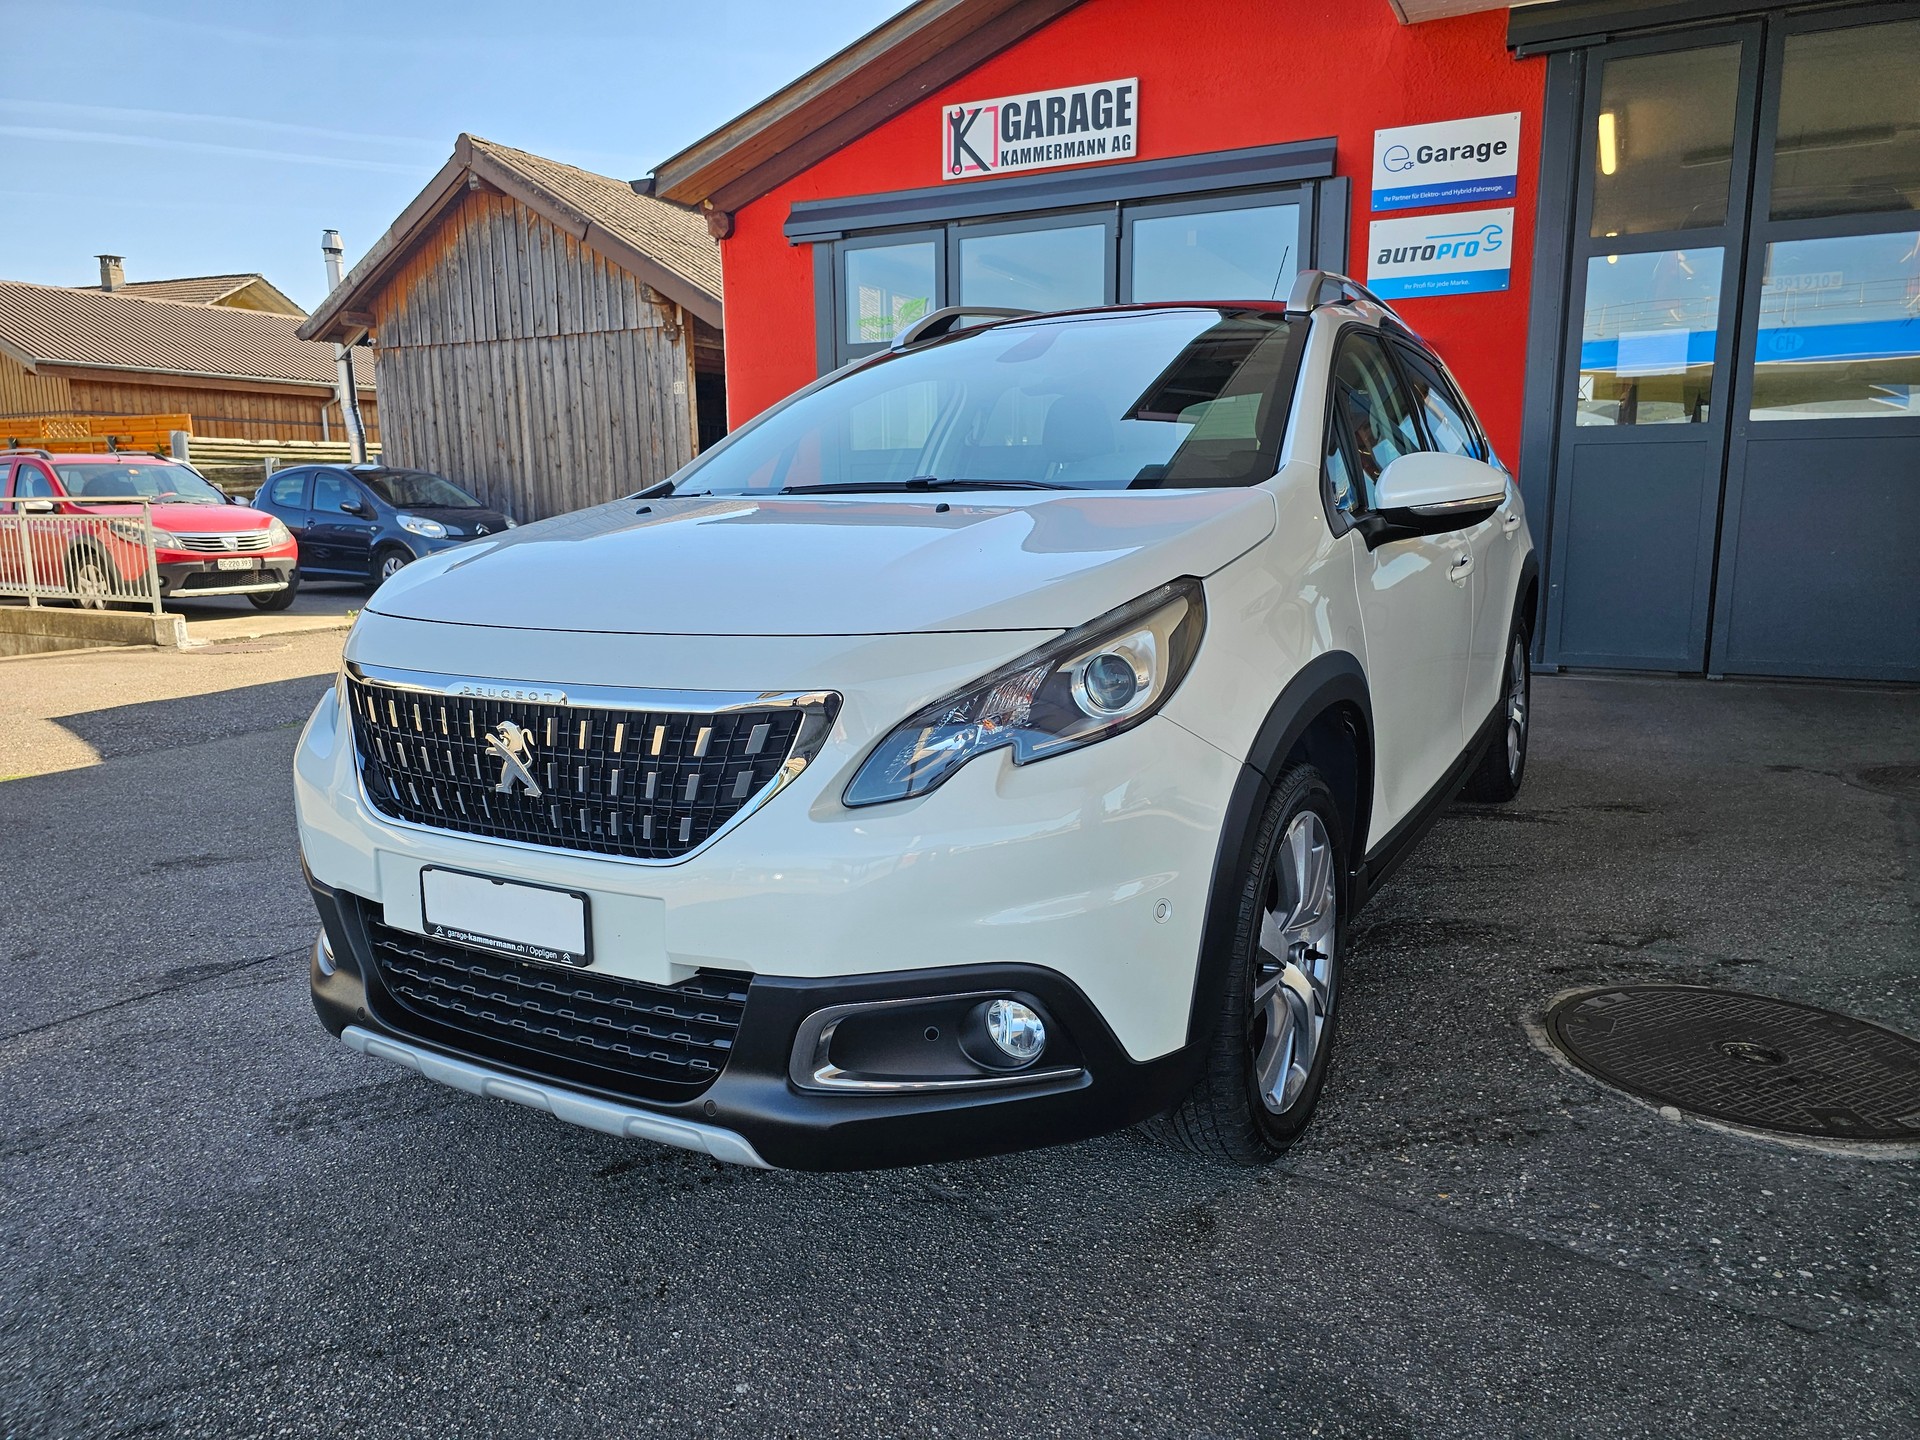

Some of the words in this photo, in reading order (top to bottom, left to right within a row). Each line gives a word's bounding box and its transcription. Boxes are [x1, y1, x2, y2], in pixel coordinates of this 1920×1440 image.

[1001, 85, 1132, 143] GARAGE
[1001, 138, 1106, 166] KAMMERMANN
[1111, 134, 1131, 152] AG
[1416, 140, 1508, 164] Garage
[1392, 194, 1411, 202] Partner
[1436, 281, 1449, 289] jede
[1775, 335, 1796, 350] CH
[463, 685, 553, 702] PEUGEOT
[447, 929, 525, 952] garage-kammermann.ch
[529, 946, 558, 960] Oppligen
